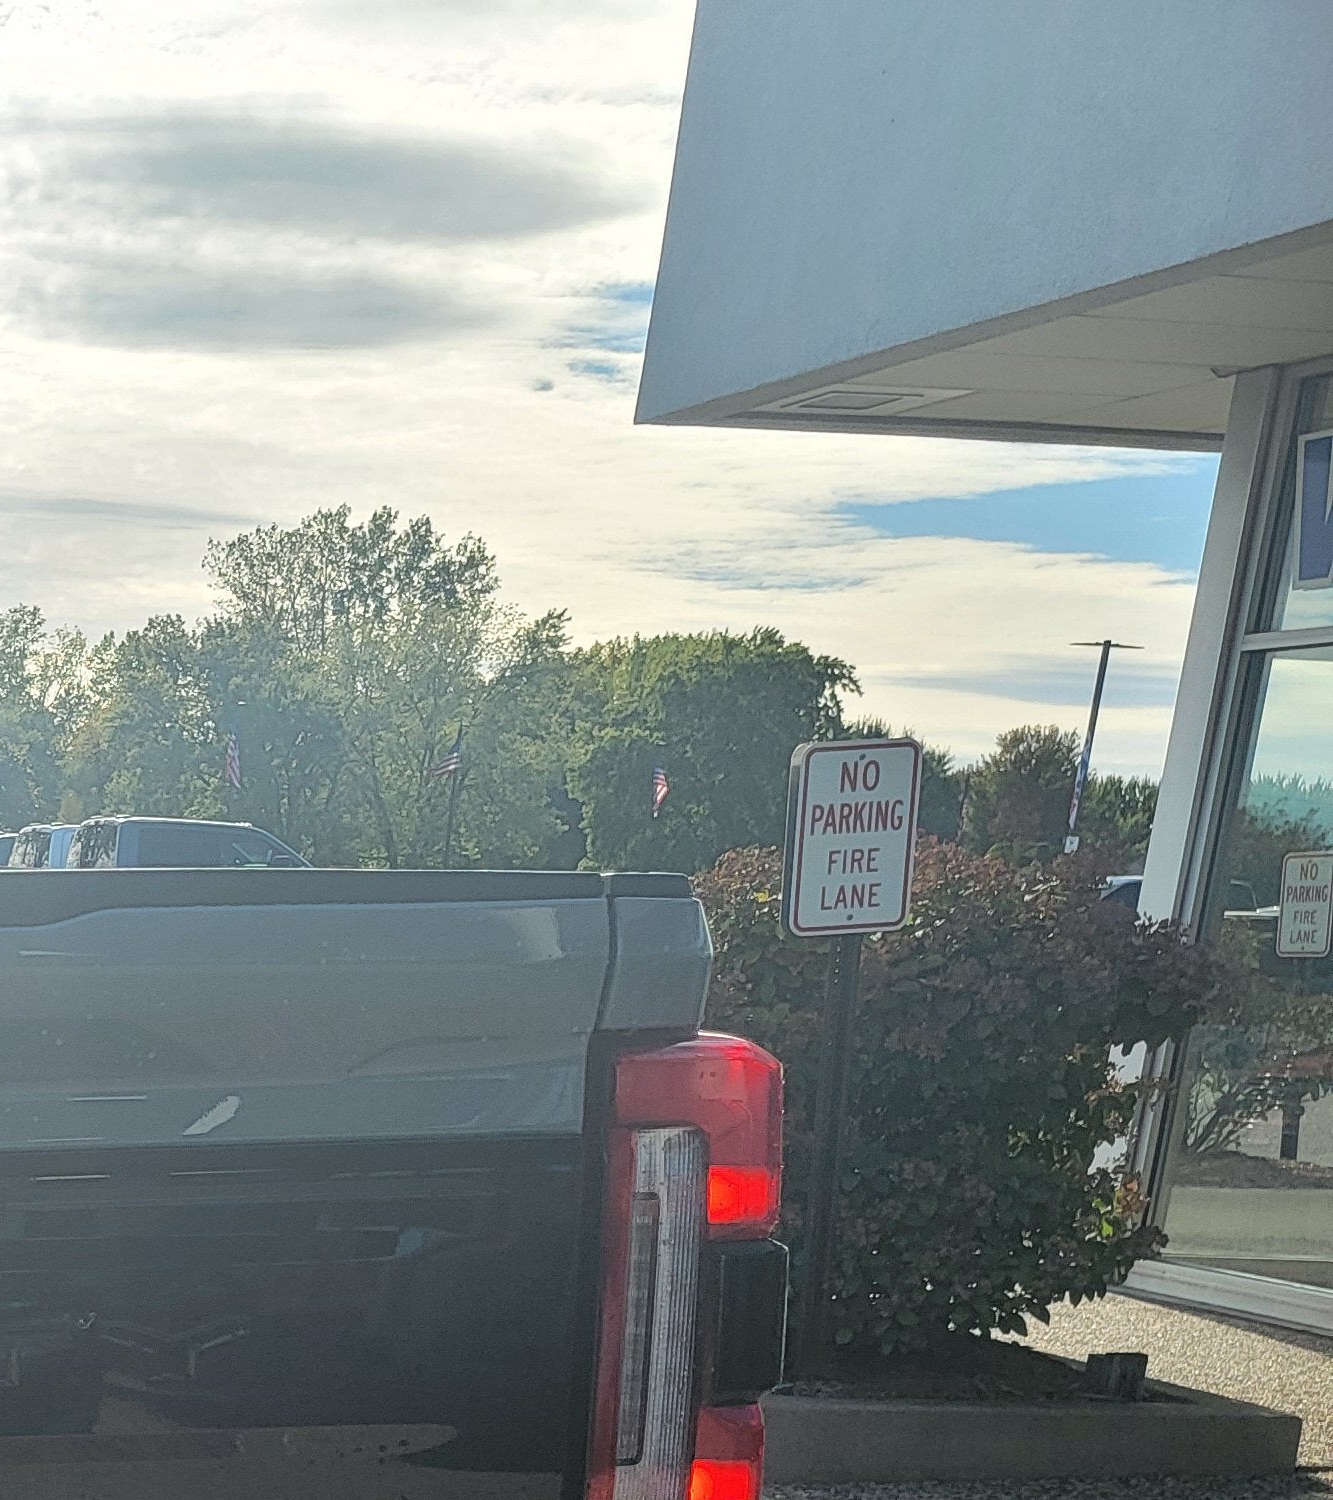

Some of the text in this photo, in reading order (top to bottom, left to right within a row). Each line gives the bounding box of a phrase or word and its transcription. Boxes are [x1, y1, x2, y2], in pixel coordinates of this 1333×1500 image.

[840, 760, 880, 793] NO
[810, 799, 904, 835] PARKING
[827, 848, 880, 875] FIRE
[1300, 863, 1318, 880] NO
[820, 882, 881, 911] LANE
[1286, 885, 1328, 903] PARKING
[1293, 910, 1318, 925] FIRE
[1290, 929, 1318, 944] LANE
